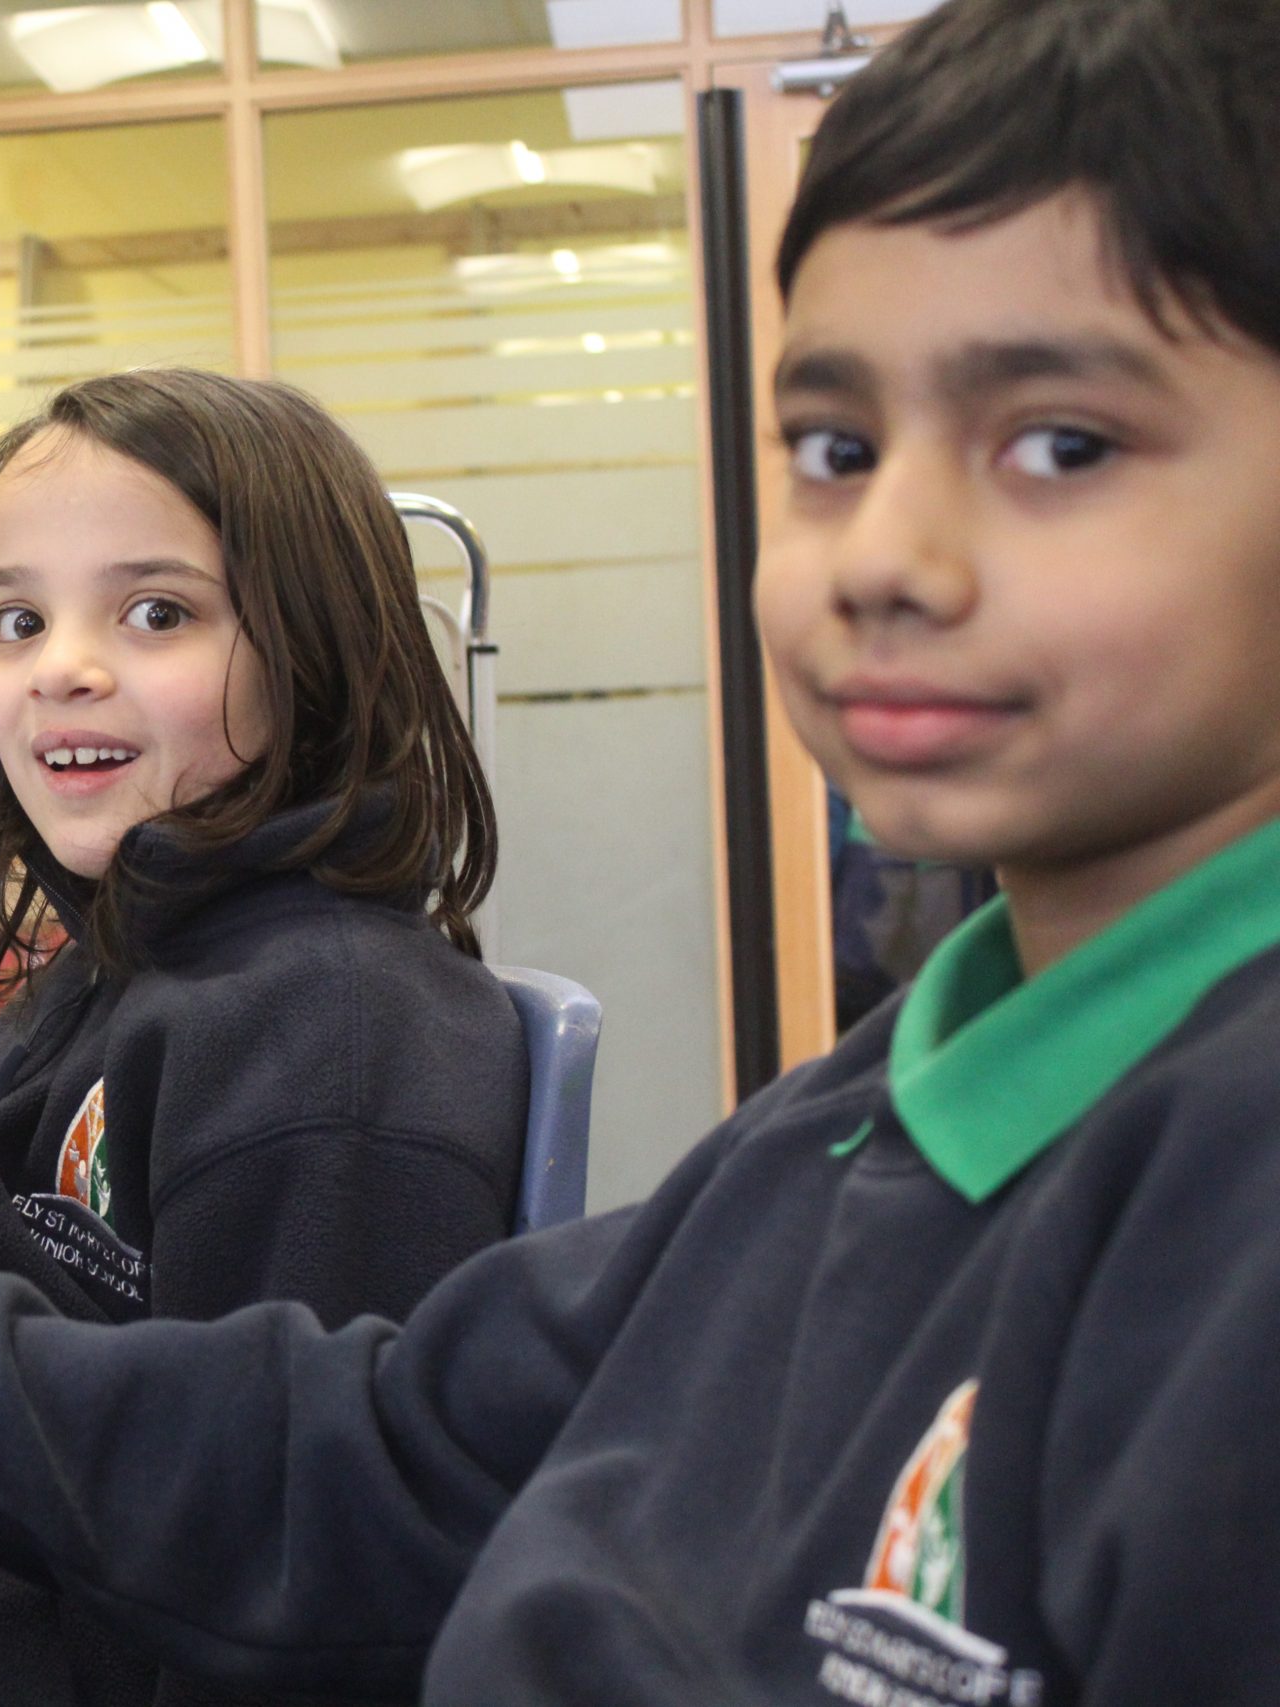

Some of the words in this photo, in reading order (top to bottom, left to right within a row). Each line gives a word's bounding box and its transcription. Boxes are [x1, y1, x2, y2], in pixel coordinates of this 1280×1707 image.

[12, 1193, 45, 1219] ELY
[44, 1209, 66, 1232] ST
[121, 1257, 147, 1278] OF
